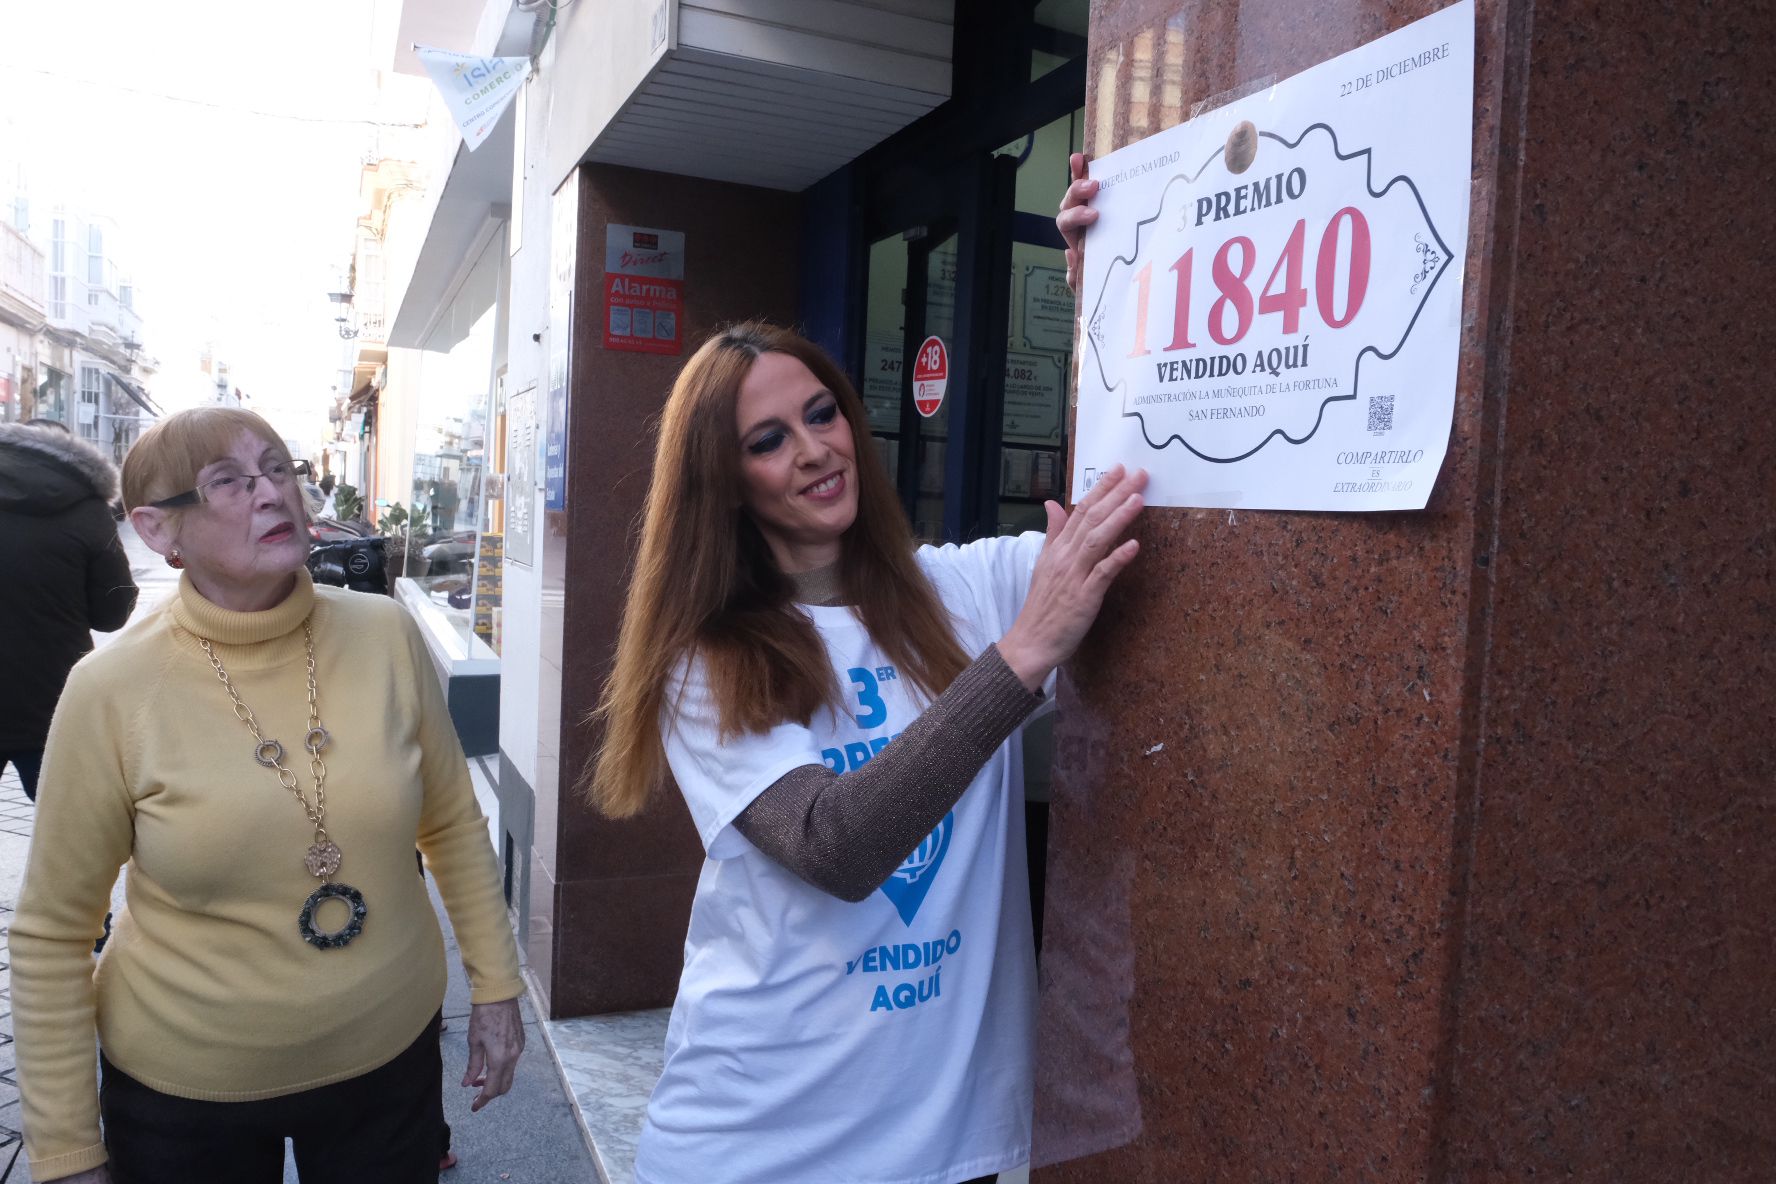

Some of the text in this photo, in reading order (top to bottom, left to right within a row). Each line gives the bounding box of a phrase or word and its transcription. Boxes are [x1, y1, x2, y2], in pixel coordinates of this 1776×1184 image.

[464, 63, 523, 105] COMERCO
[1340, 43, 1450, 97] 22 DE DICIEMBRE
[1129, 166, 1141, 179] DE
[1141, 151, 1181, 173] NAVIDAD
[1195, 167, 1307, 227] PREMIO
[610, 277, 677, 299] Alarma
[1126, 206, 1372, 360] 11840
[921, 345, 941, 371] +18
[1156, 335, 1310, 384] VENDIDO AQUÍ
[1134, 378, 1338, 405] ADMINISTRACIÓN LA MUÑEQUITA DE LA FORTUNA
[1188, 405, 1266, 421] SAN FERNANDO
[1336, 449, 1424, 465] COMPARTIRLO
[1371, 470, 1381, 478] ES
[846, 929, 962, 975] VENDIDO
[869, 965, 942, 1012] AQUÍ
